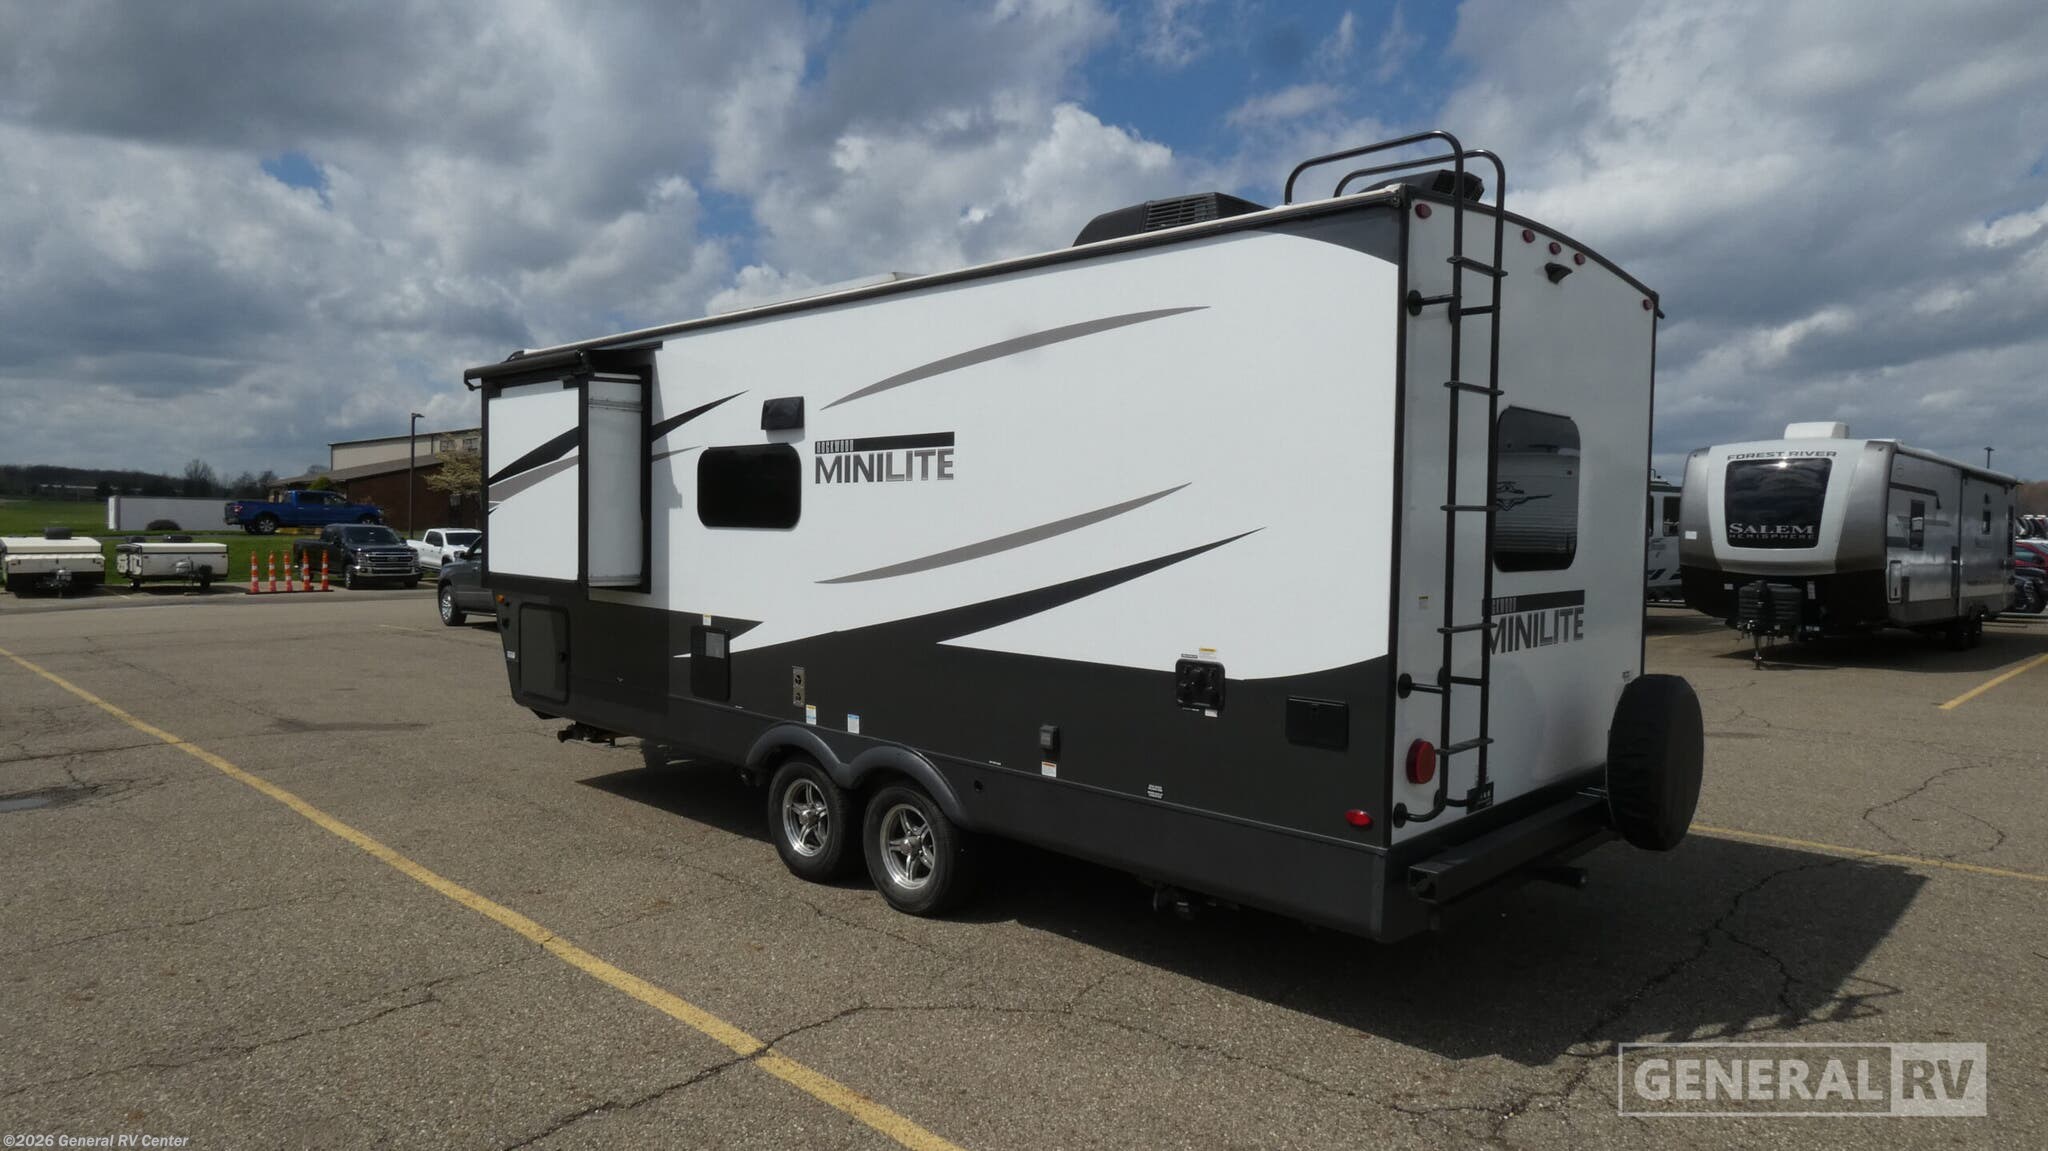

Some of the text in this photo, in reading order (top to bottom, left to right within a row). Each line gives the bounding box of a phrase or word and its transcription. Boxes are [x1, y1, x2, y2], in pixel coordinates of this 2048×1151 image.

[817, 440, 854, 453] ROCKWOOD
[1728, 450, 1838, 460] FOREST RIVER
[815, 448, 954, 484] MINILITE
[1729, 522, 1815, 534] SALEM
